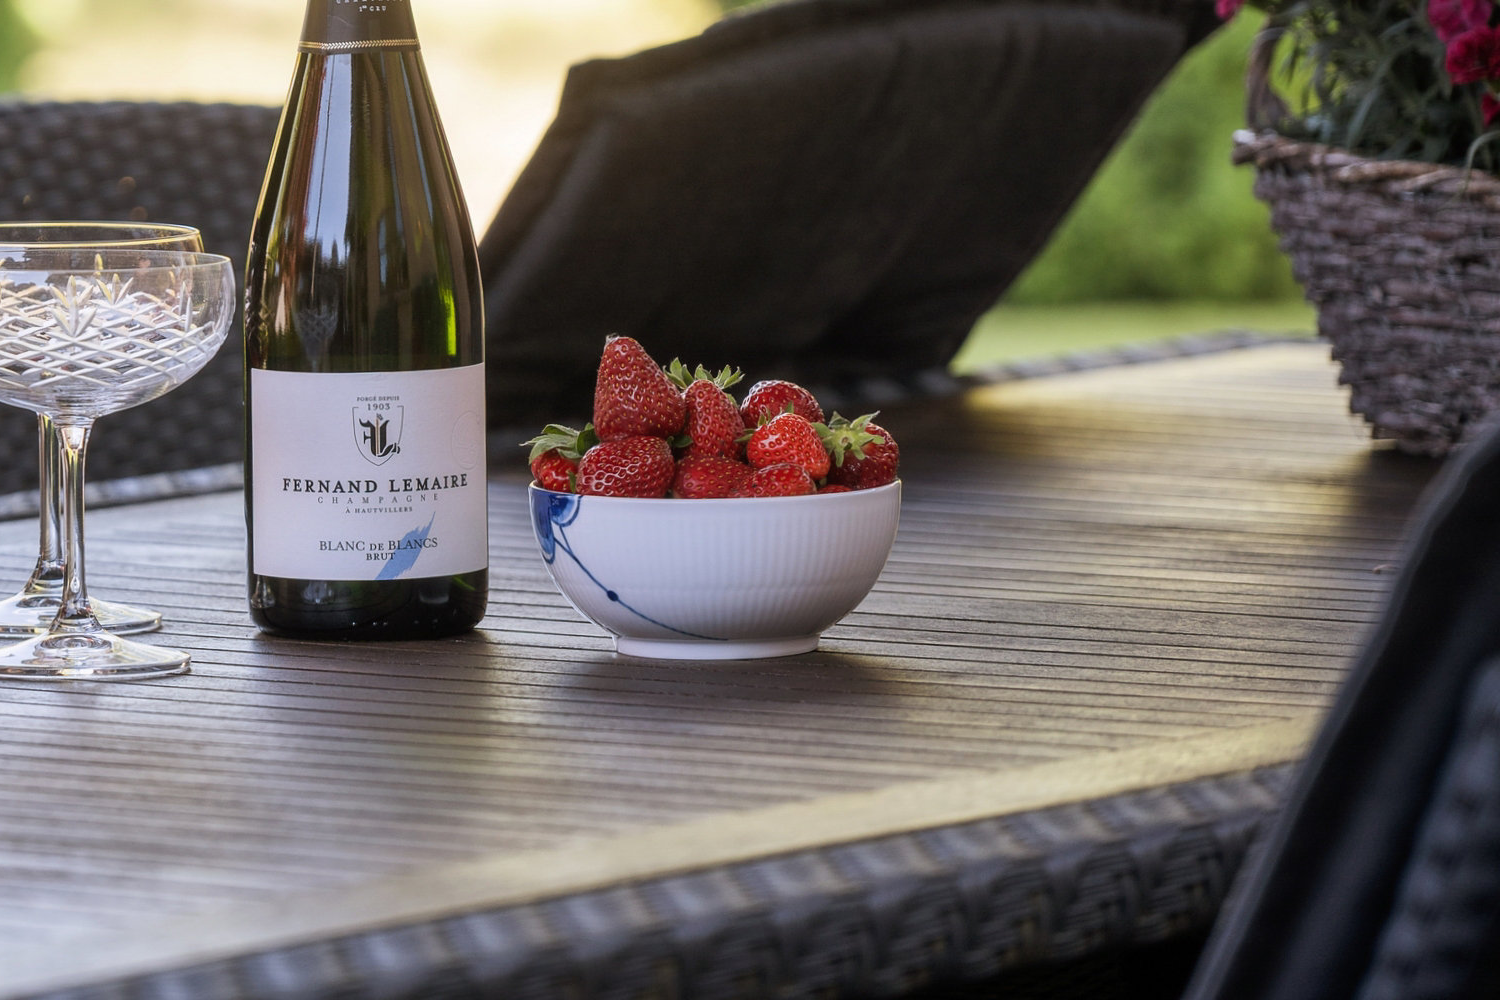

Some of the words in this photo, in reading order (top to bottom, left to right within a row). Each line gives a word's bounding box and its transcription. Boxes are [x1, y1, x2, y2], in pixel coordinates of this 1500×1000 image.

[368, 403, 390, 411] 1903
[283, 478, 378, 493] FERNAND
[389, 473, 468, 493] LEMAIRE
[318, 493, 438, 504] CHAMPAGNE
[355, 506, 413, 514] HAUTVILLERS
[319, 540, 366, 552] BLANC
[388, 537, 438, 551] BLANCS
[366, 552, 396, 561] BRUT
